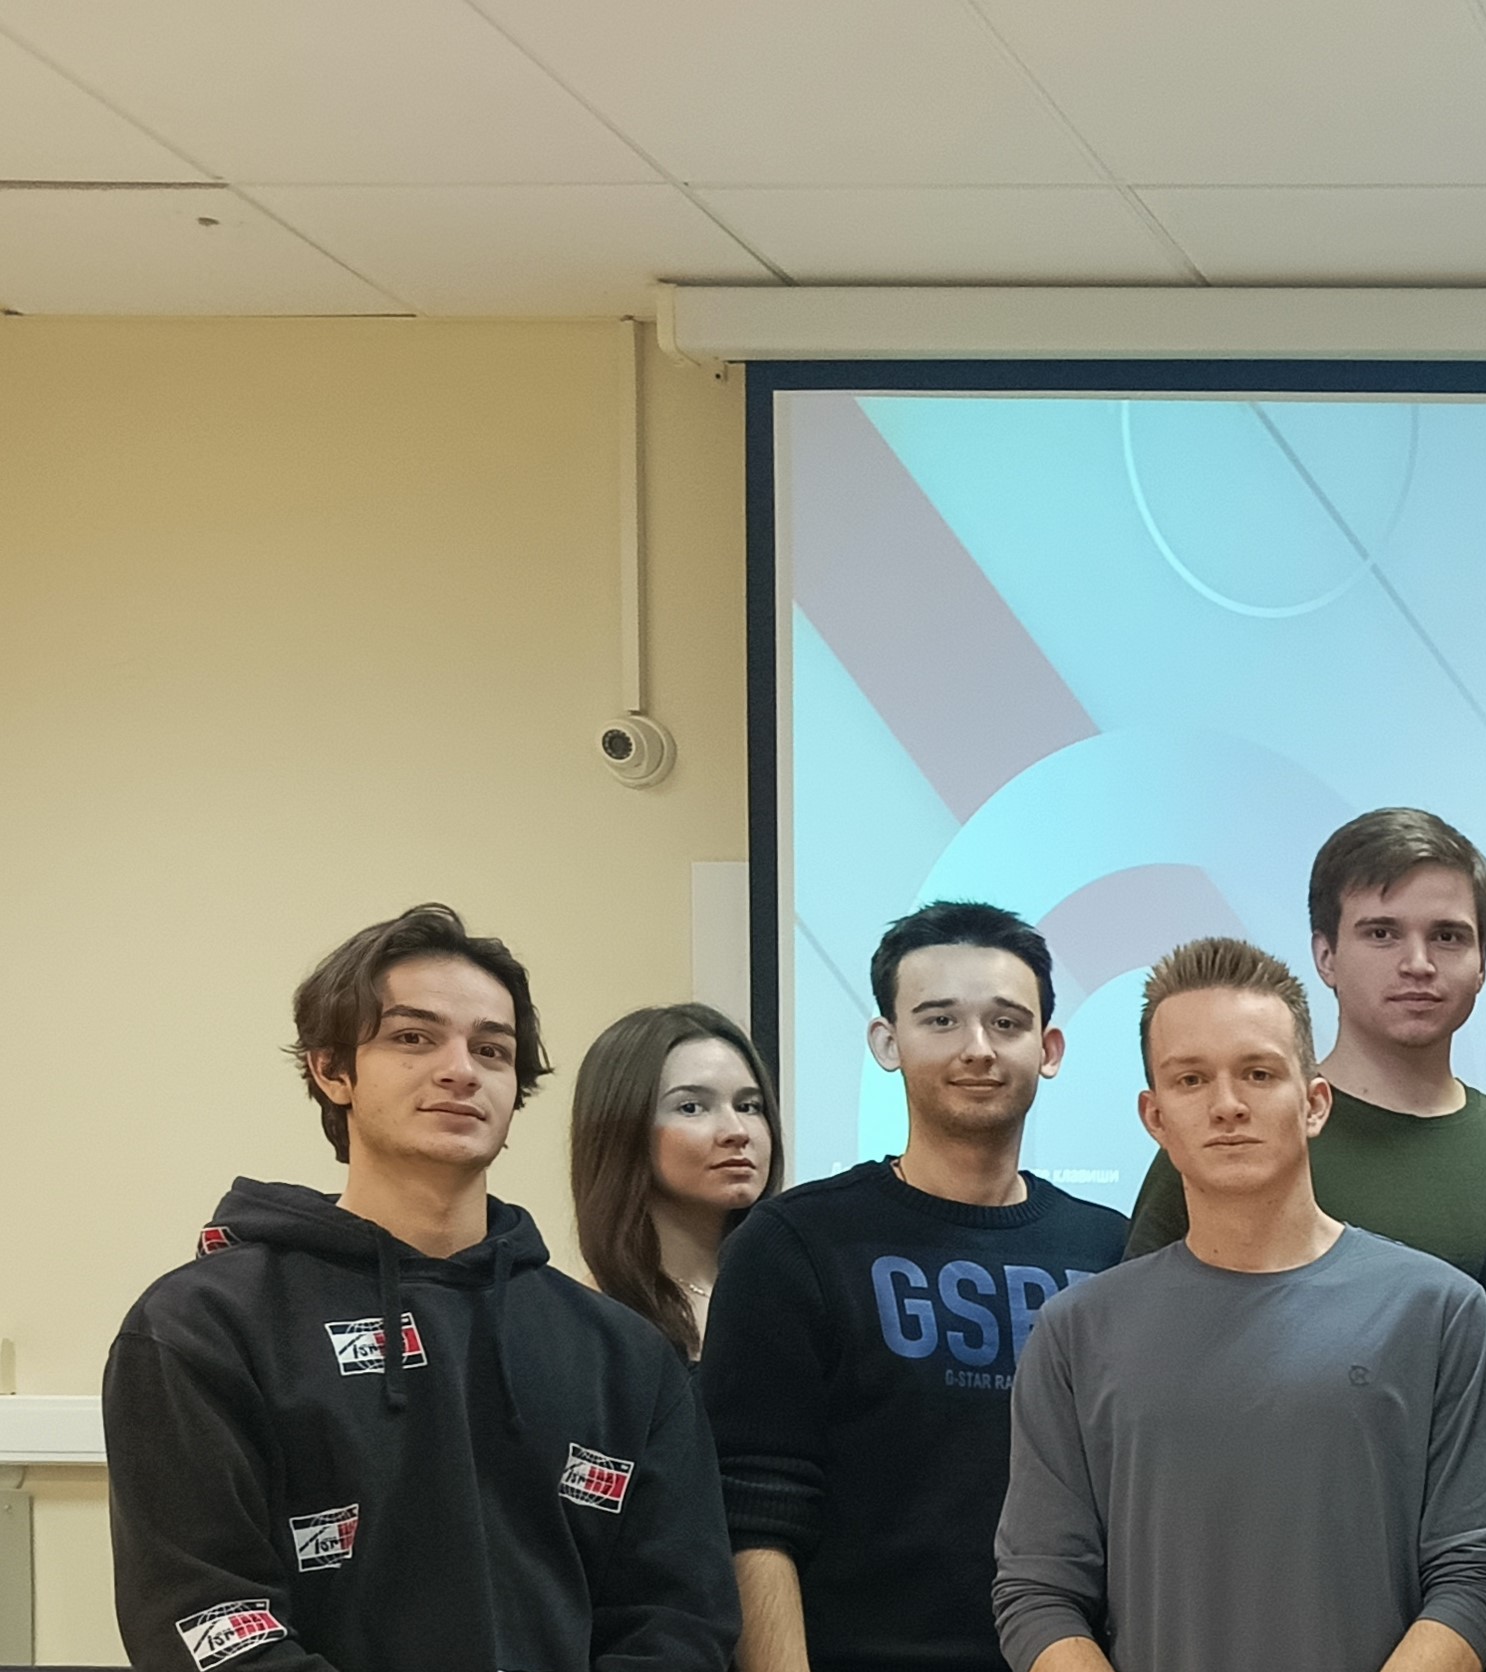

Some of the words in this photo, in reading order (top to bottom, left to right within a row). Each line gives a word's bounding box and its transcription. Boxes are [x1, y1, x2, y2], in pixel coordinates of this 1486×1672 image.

[871, 1255, 1097, 1368] GSR
[945, 1368, 992, 1389] G-STAR
[994, 1374, 1014, 1390] RA
